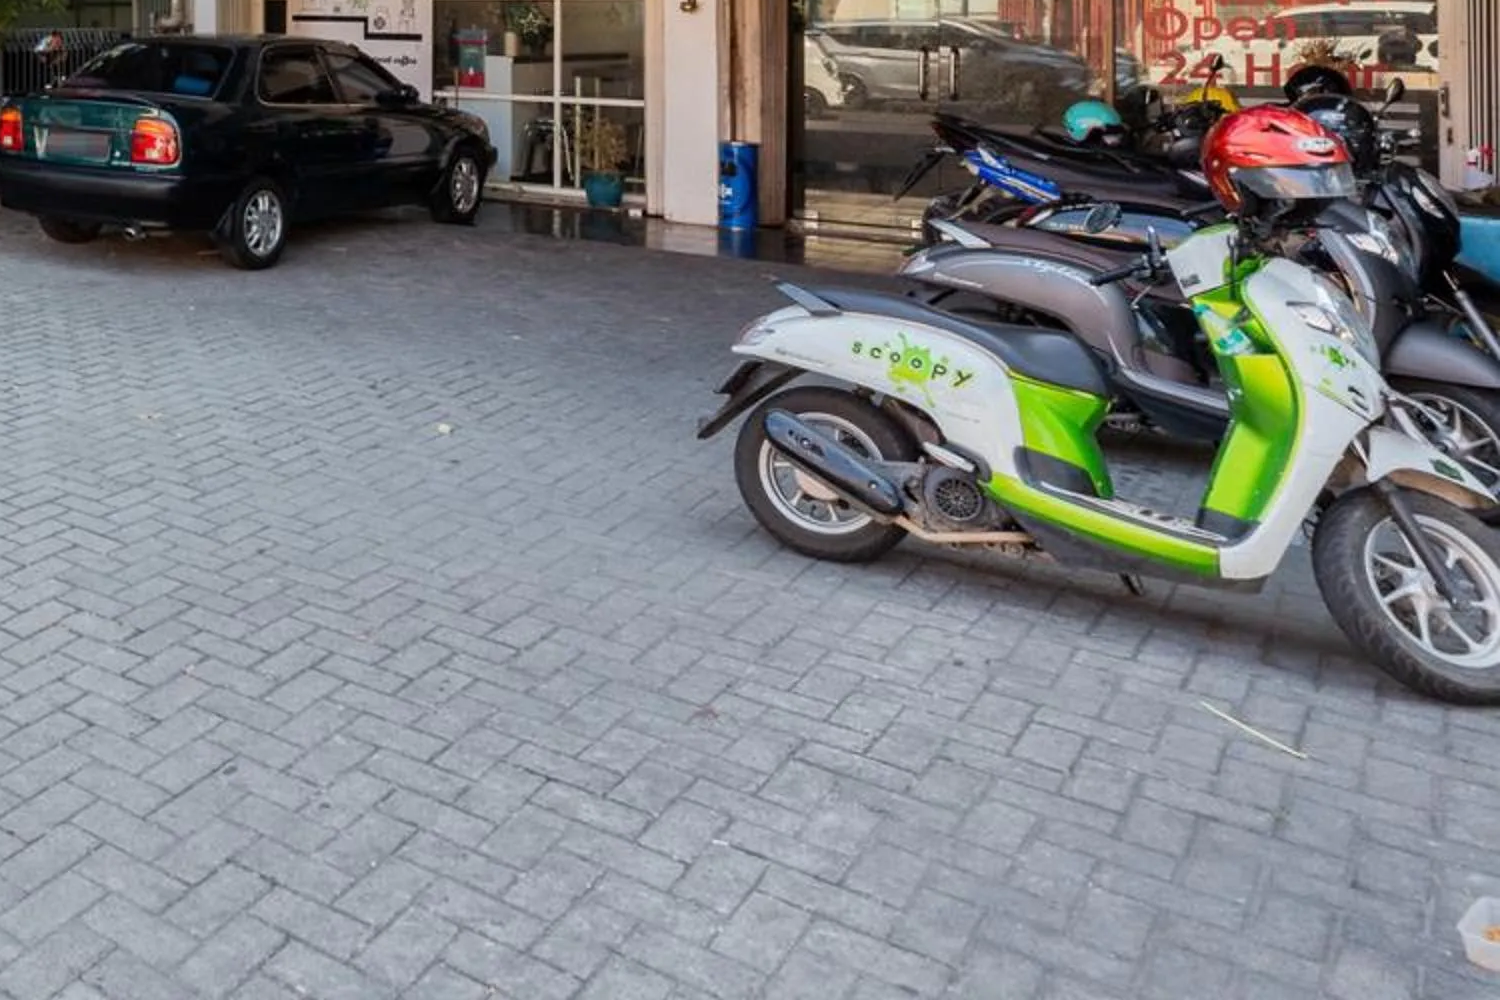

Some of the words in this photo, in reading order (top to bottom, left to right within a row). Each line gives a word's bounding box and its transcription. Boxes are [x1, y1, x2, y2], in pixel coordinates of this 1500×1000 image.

[1145, 6, 1298, 50] Open
[1158, 50, 1223, 87] 24
[1245, 52, 1390, 89] Hur
